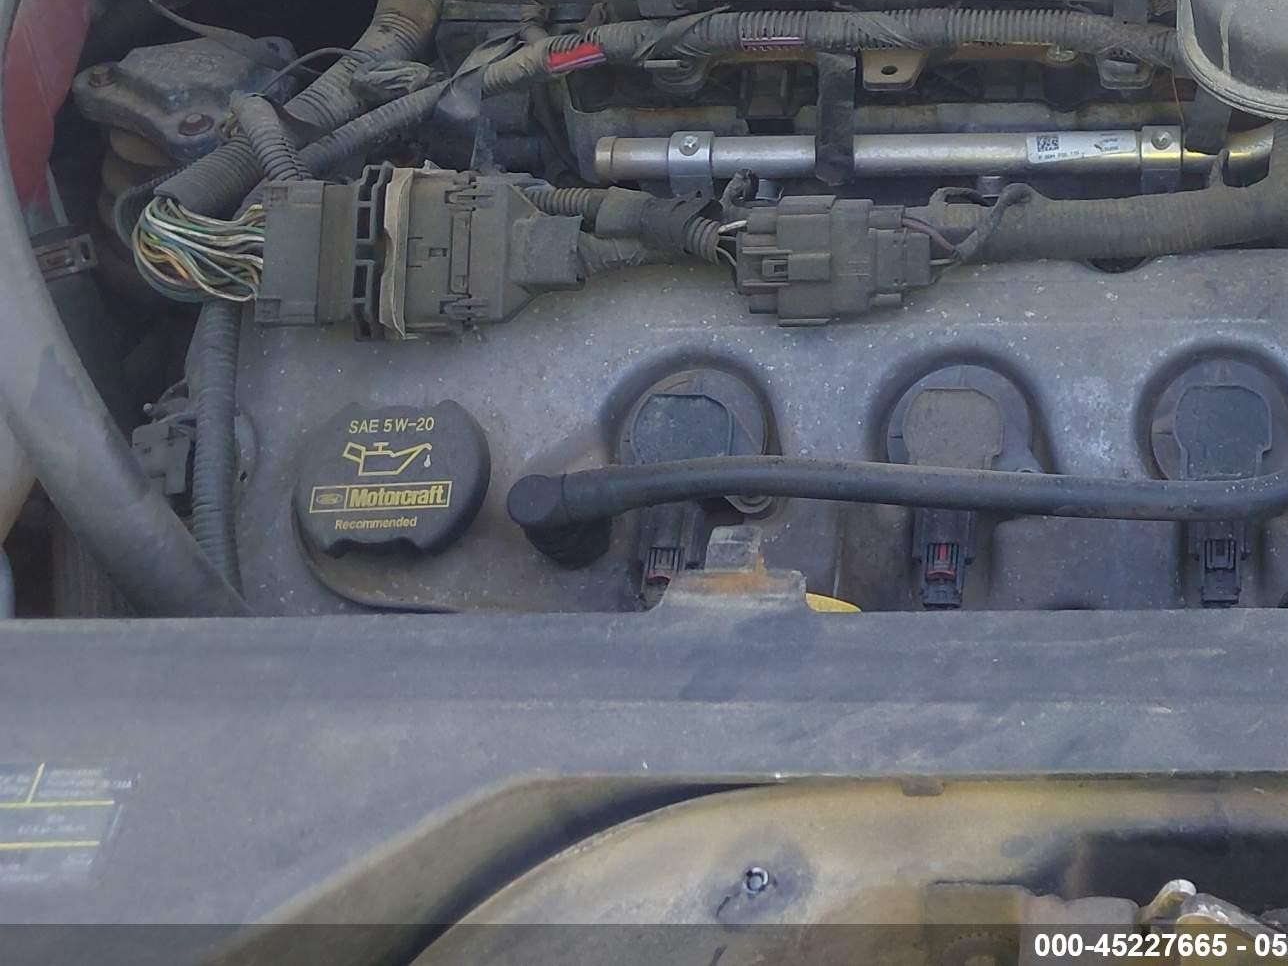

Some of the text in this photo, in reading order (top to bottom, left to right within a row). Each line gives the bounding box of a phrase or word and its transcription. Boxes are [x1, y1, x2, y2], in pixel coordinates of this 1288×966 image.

[349, 417, 435, 433] SAE 5W-20
[335, 516, 417, 530] Recommended
